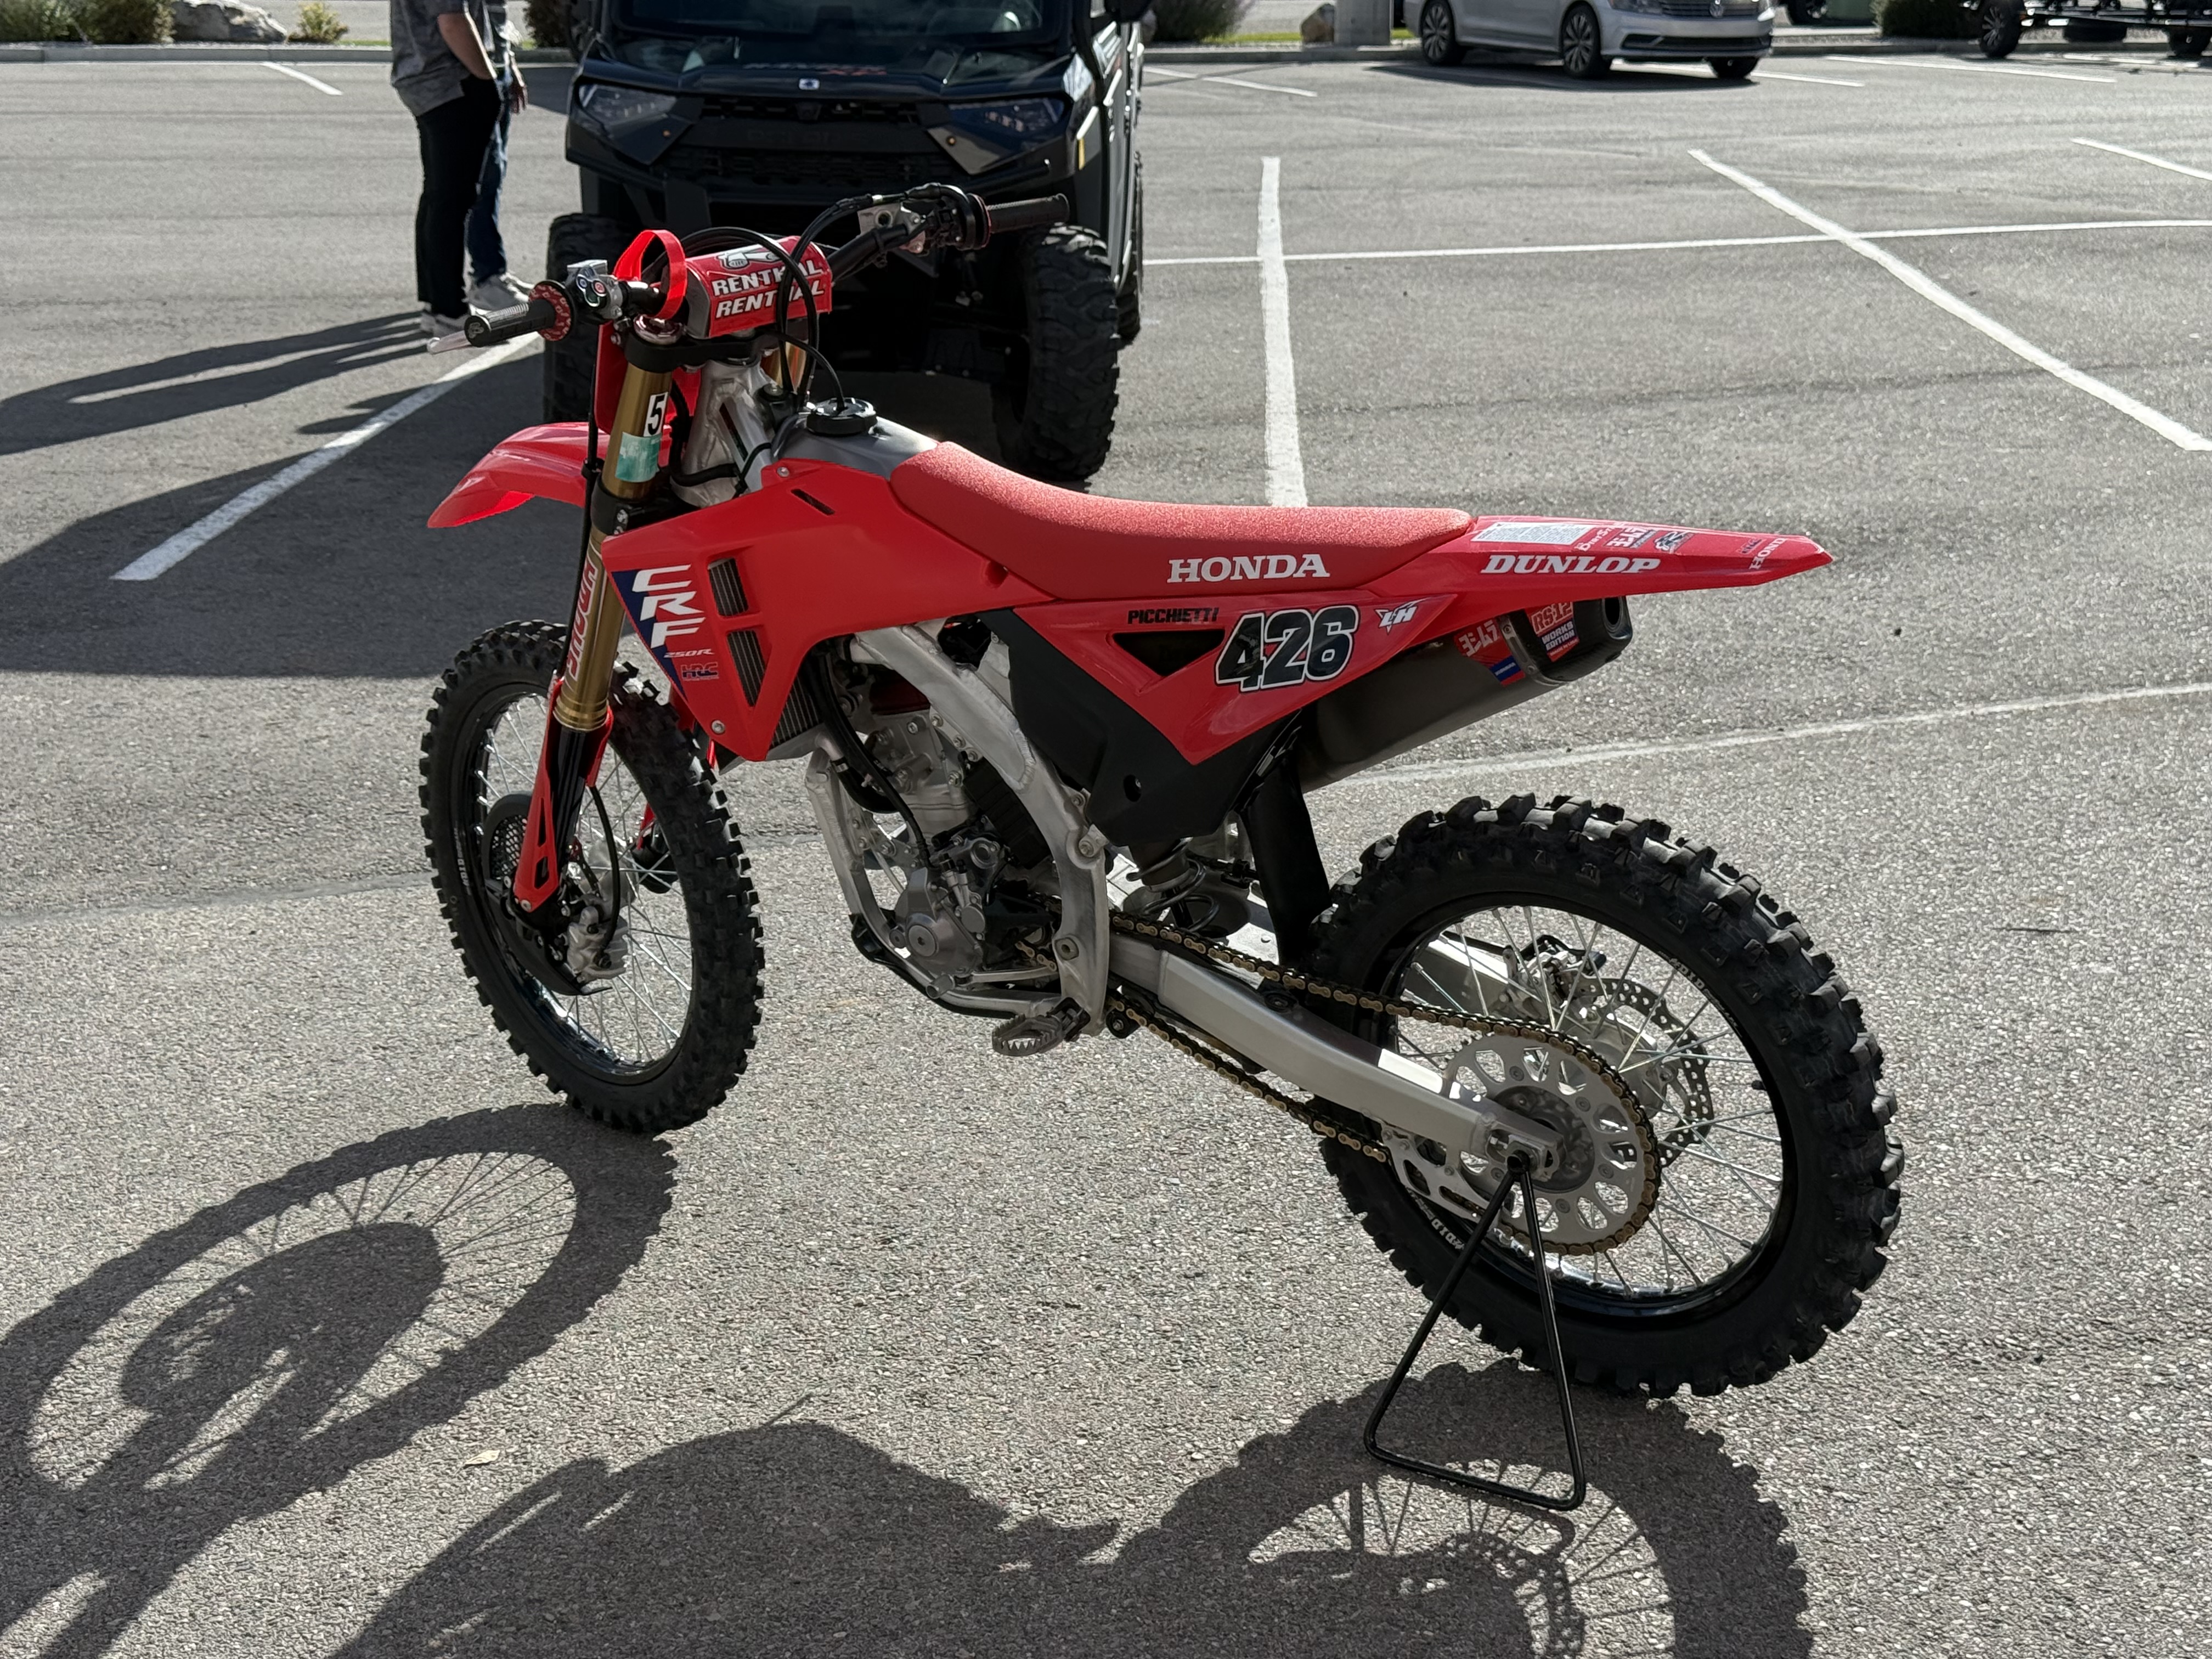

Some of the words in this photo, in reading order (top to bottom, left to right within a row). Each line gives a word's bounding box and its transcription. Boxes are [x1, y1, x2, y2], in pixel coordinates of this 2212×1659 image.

[648, 394, 665, 436] 5
[1481, 555, 1661, 574] DUNLOP
[1749, 538, 1788, 569] HOND
[1167, 554, 1330, 583] HONDA
[632, 564, 706, 648] CRF
[1128, 608, 1220, 624] PICCHIETTI
[1458, 619, 1499, 657] ヨシムラ
[1542, 621, 1574, 645] WORKS
[1545, 629, 1575, 651] EDITION
[663, 648, 715, 658] 250R
[1215, 605, 1362, 693] 426
[681, 662, 719, 679] HRC
